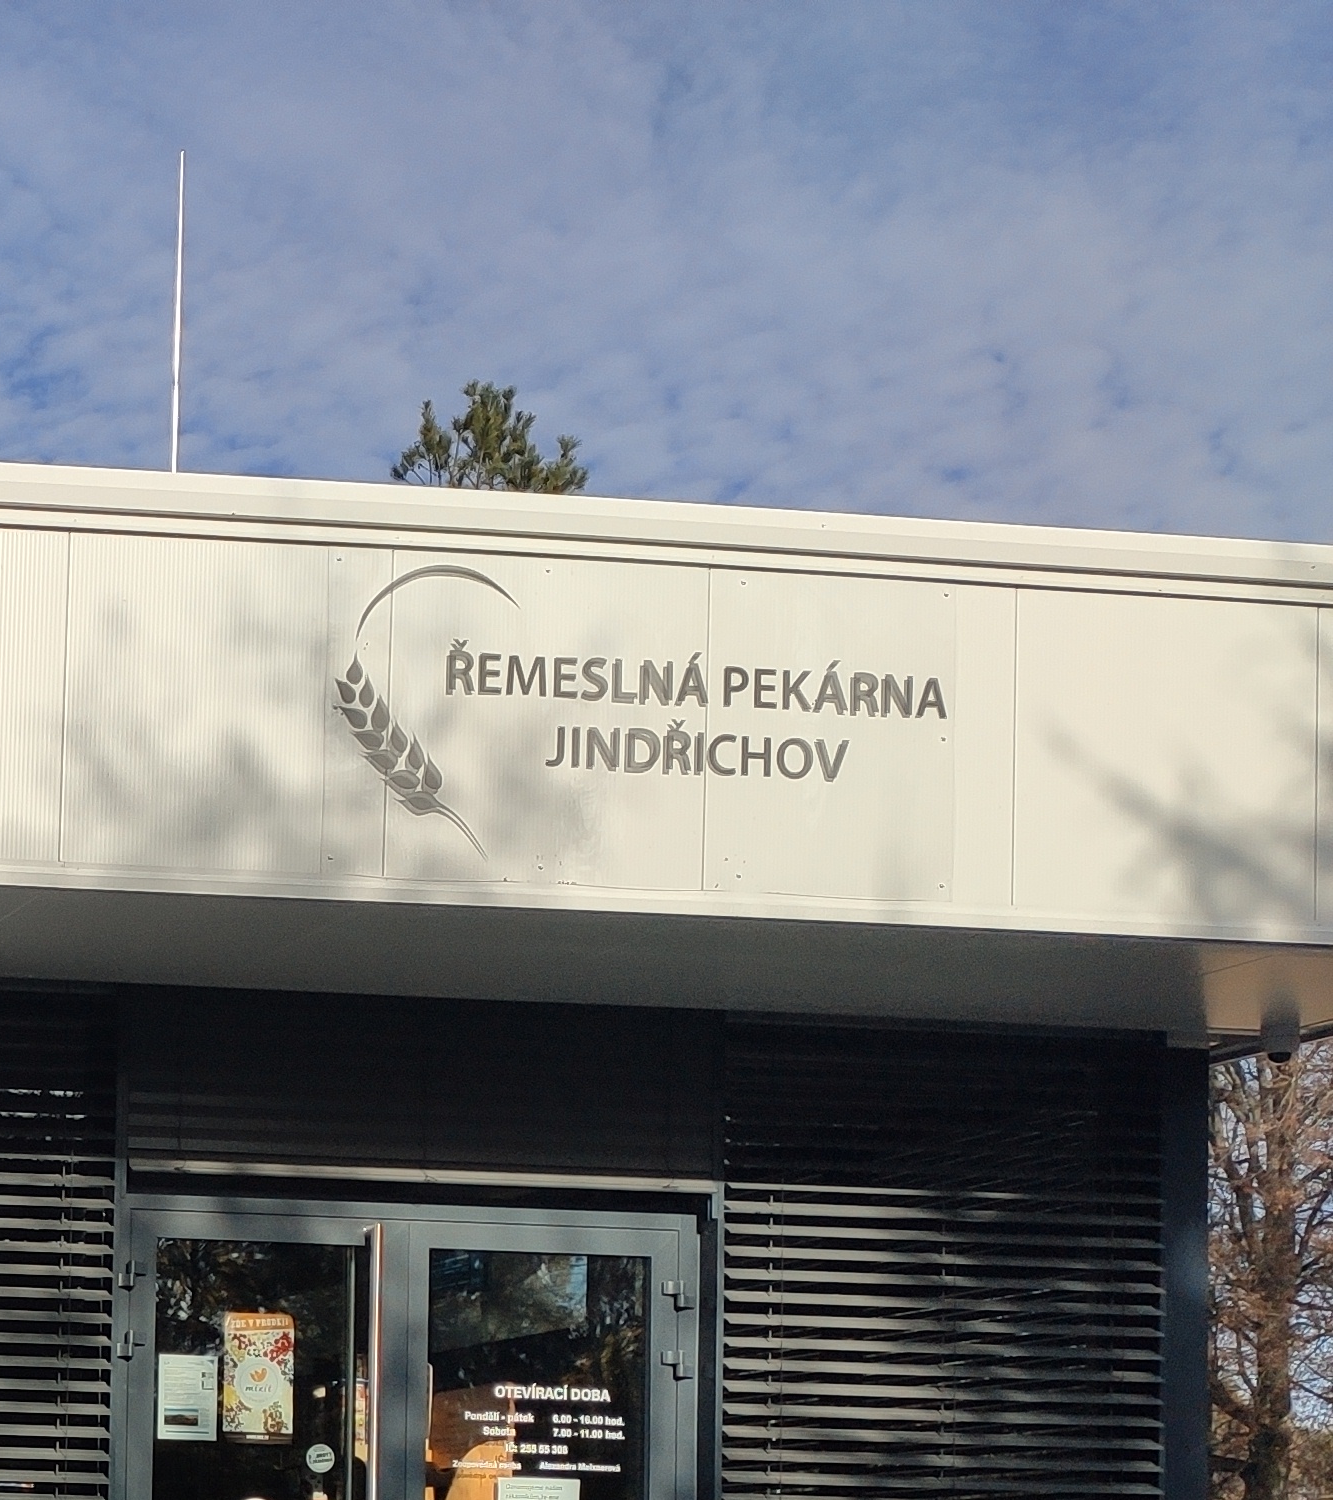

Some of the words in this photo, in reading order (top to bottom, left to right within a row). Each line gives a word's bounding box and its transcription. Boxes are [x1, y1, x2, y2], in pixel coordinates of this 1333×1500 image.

[445, 638, 709, 708] ŘEMESLNÁ
[722, 659, 948, 719] PEKÁRNA
[544, 718, 851, 783] JINDŘICHOV
[495, 1383, 568, 1401] OTEVÍRACÍ
[571, 1388, 612, 1403] DOBA
